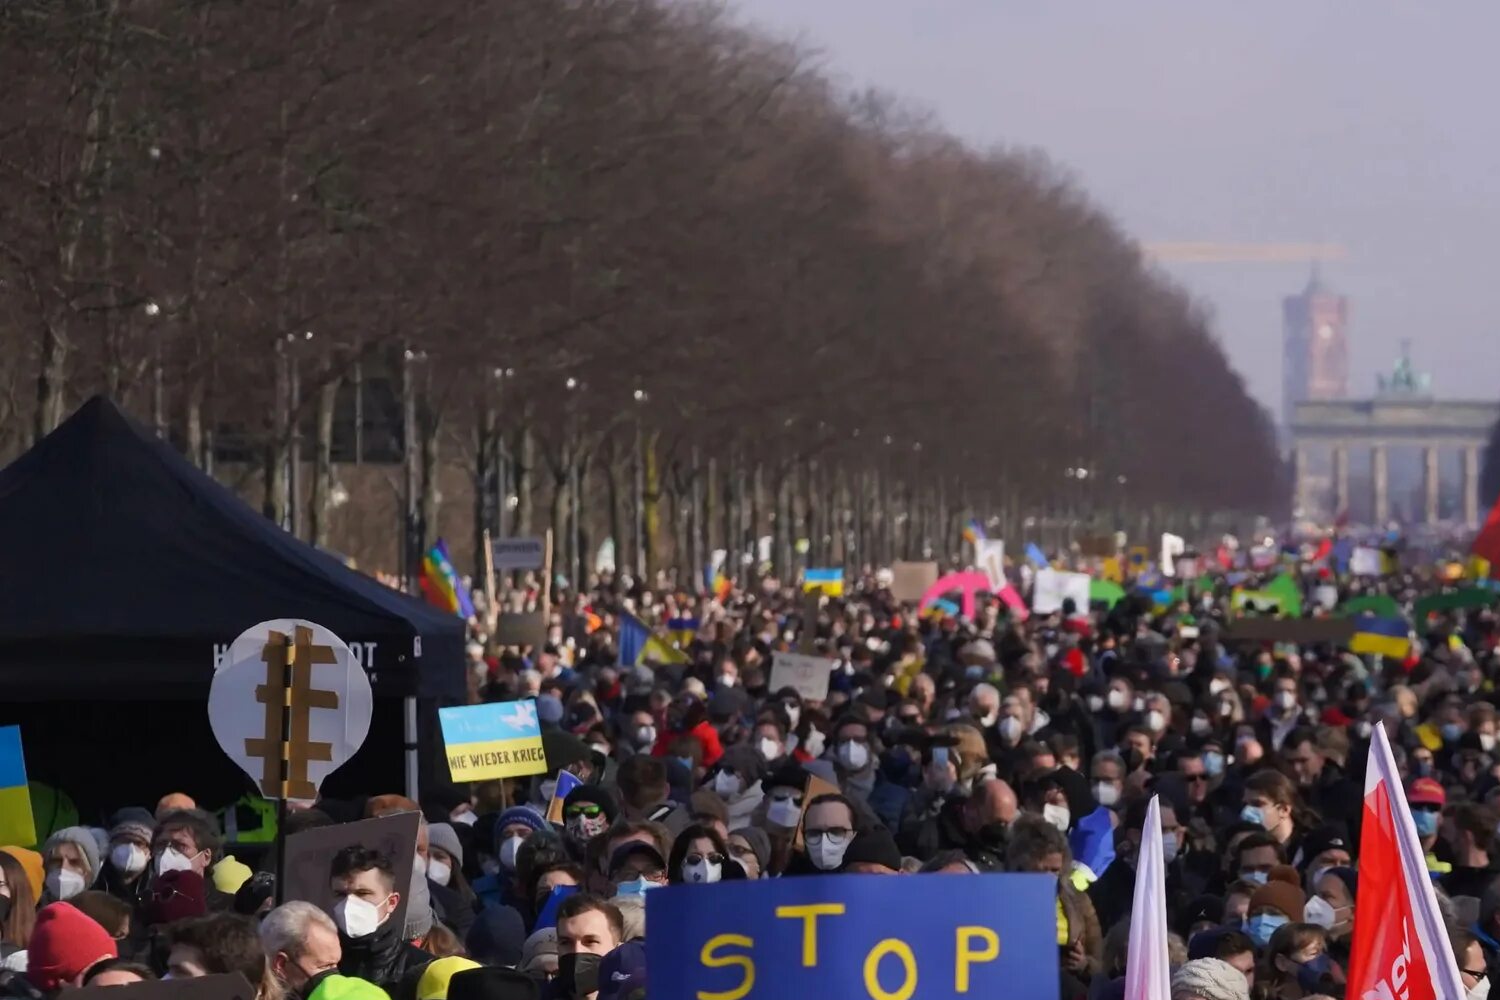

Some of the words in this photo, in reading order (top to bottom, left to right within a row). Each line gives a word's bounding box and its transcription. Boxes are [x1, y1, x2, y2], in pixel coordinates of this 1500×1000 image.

[448, 755, 468, 770] NIE
[469, 751, 511, 768] WIEDER
[512, 747, 545, 764] KRIEG
